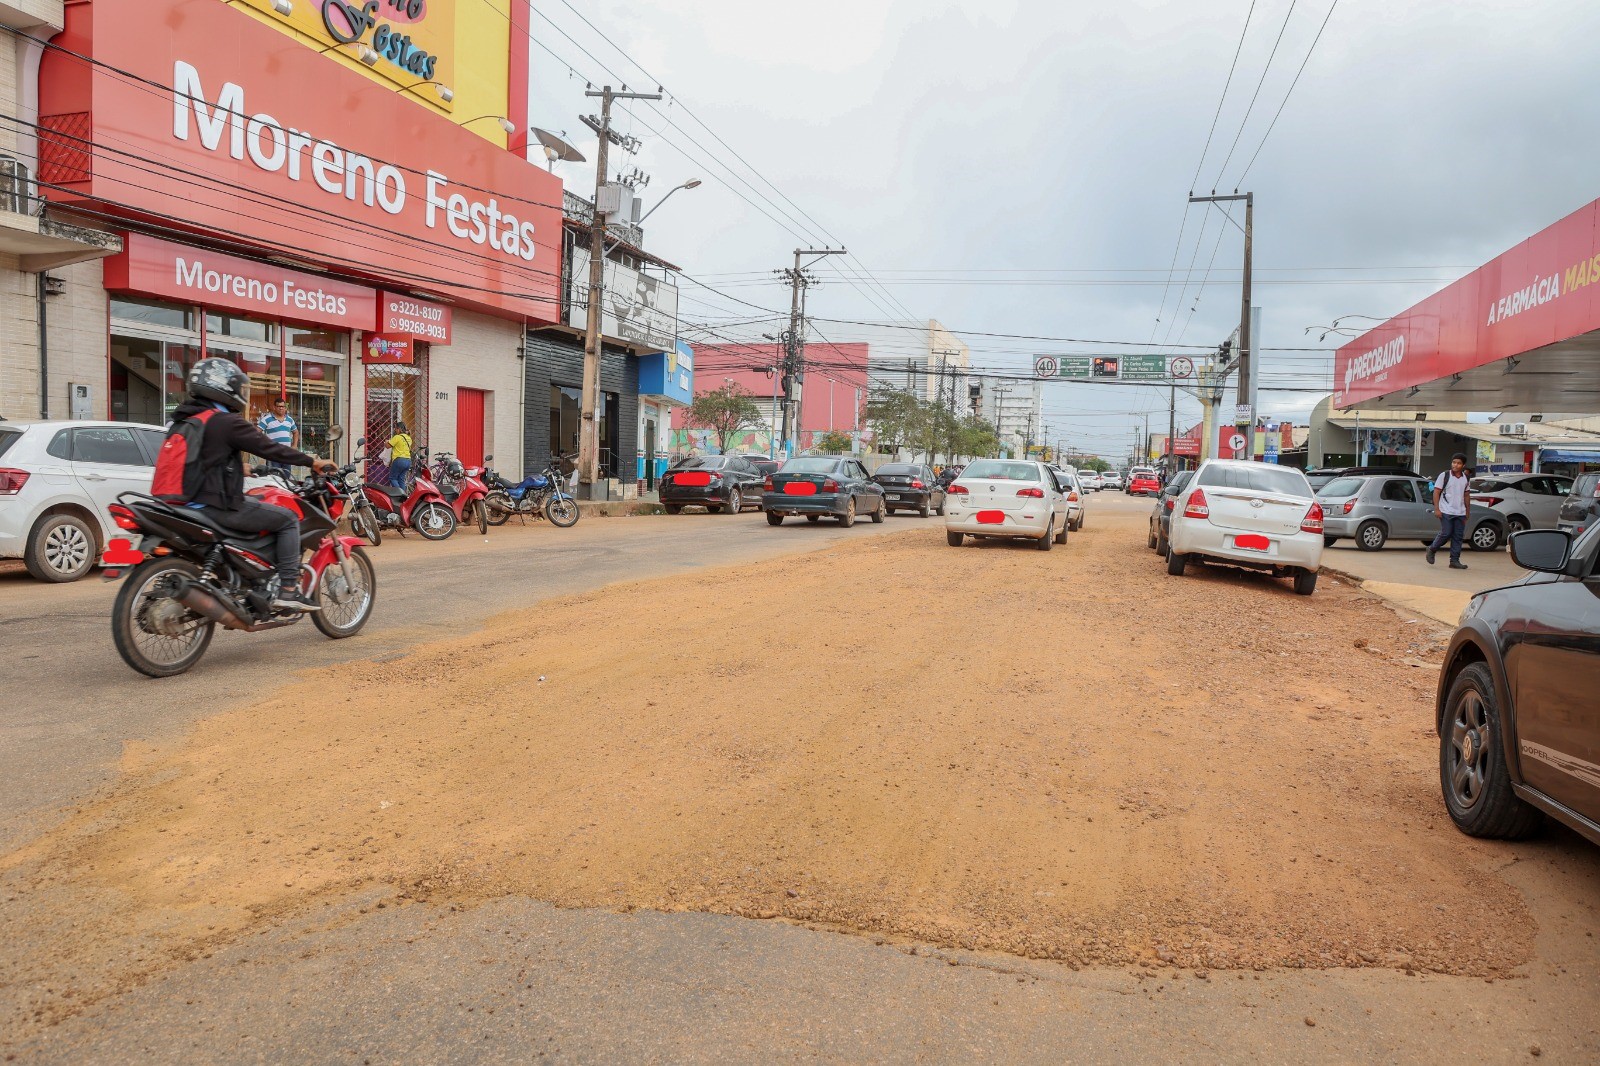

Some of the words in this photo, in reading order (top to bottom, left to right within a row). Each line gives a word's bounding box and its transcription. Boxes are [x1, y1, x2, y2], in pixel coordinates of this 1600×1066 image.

[321, 0, 438, 80] Festas
[173, 59, 406, 214] Moreno
[425, 169, 536, 261] Festas
[175, 257, 278, 303] Moreno
[283, 280, 347, 316] Festas
[1486, 302, 1496, 327] A
[1496, 272, 1560, 322] FARMÁCIA
[1562, 253, 1600, 295] MAIS
[398, 300, 443, 322] 3221-8107
[398, 318, 447, 340] 99268-9031
[387, 340, 408, 348] Festas
[1038, 360, 1053, 371] 40
[1103, 362, 1117, 372] 74
[1352, 334, 1405, 382] PREÇOBAIXO
[435, 391, 449, 401] 2011
